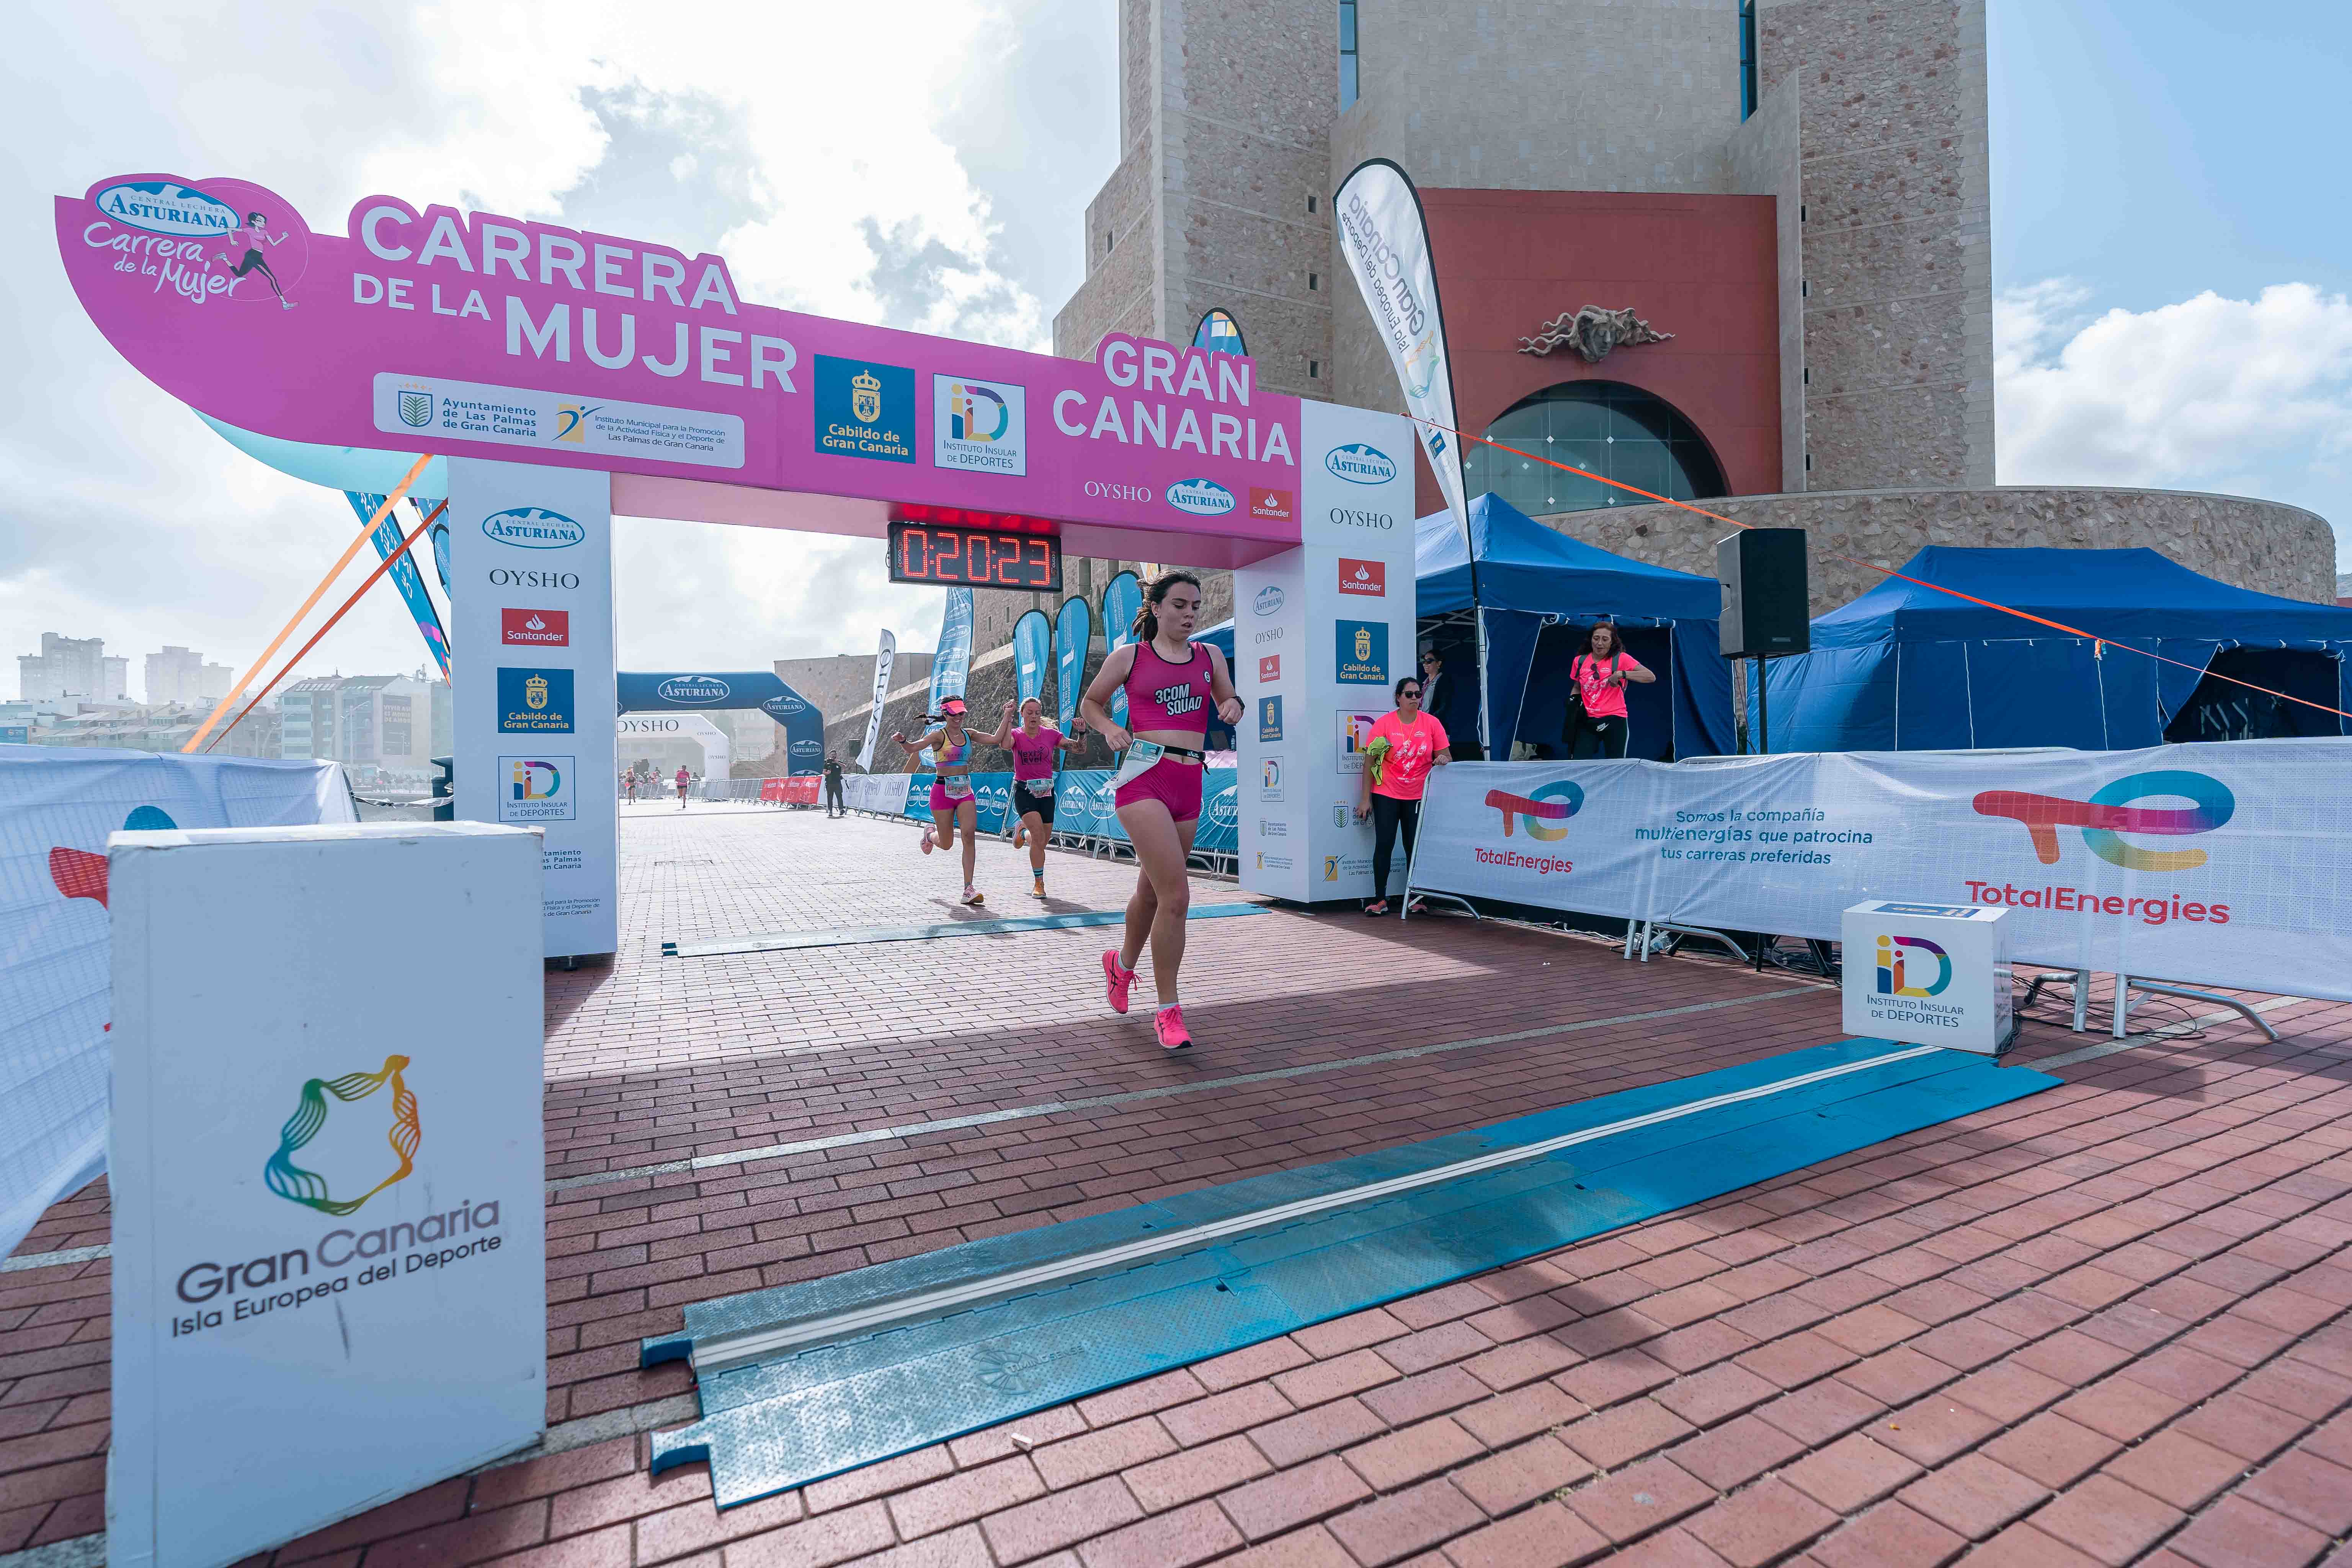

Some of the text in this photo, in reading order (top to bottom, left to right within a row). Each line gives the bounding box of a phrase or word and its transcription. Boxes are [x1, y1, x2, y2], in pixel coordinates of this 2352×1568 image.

[108, 193, 229, 229] ASTURIANA
[131, 195, 225, 214] CENTRAL LECHERA
[83, 222, 203, 261] Carrera
[361, 206, 738, 315] CARRERA
[114, 254, 247, 304] de la Mujer
[354, 273, 797, 393] DE LA MUJER
[1104, 341, 1249, 406] GRAN
[443, 398, 536, 416] Ayuntamiento
[443, 409, 536, 426] de Las Palmas
[595, 415, 624, 424] Instituto
[626, 419, 660, 429] Municipal
[689, 426, 725, 436] Promoción
[443, 420, 536, 437] de Gran Canaria
[616, 426, 649, 435] Actividad
[686, 434, 714, 443] Deporte
[828, 424, 899, 443] Cabildo de
[1053, 390, 1295, 466] CANARIA
[623, 436, 650, 444] Palmas
[665, 439, 683, 448] Gran
[685, 443, 713, 451] Canaria
[823, 436, 908, 456] Gran Canaria
[944, 440, 1016, 457] INSTITUTO INSULAR
[960, 454, 1013, 468] DEPORTES
[1331, 455, 1391, 477] ASTURIANA
[1085, 481, 1152, 502] OYSHO
[1171, 491, 1231, 509] ASTURIANA
[1253, 506, 1289, 518] Santander
[1330, 508, 1392, 529] OYSHO
[491, 519, 577, 540] ASTURIANA
[904, 530, 1050, 585] 0:20:23
[489, 569, 580, 589] OYSHO
[1343, 580, 1381, 591] Santander
[1256, 597, 1282, 611] ASTURIANA
[508, 631, 564, 640] Santander
[1256, 627, 1283, 644] OYSHO
[1261, 671, 1279, 679] Santander
[664, 684, 724, 696] ASTURIANA
[1155, 683, 1190, 703] 3COM
[1167, 696, 1203, 715] SQUAD
[1676, 807, 1824, 824] Somos la compañía
[1636, 825, 1872, 844] multienergías que patrocina
[1474, 848, 1573, 875] TotalEnergies
[1661, 848, 1831, 866] tus carreras preferidas
[1965, 880, 2230, 925] TotalEnergies
[1867, 995, 1963, 1014] INSTITUTO INSULAR
[1872, 1009, 1959, 1027] DE DEPORTES
[176, 1199, 499, 1303] Gran Canaria
[172, 1236, 501, 1339] Isla Europea del Deporte
